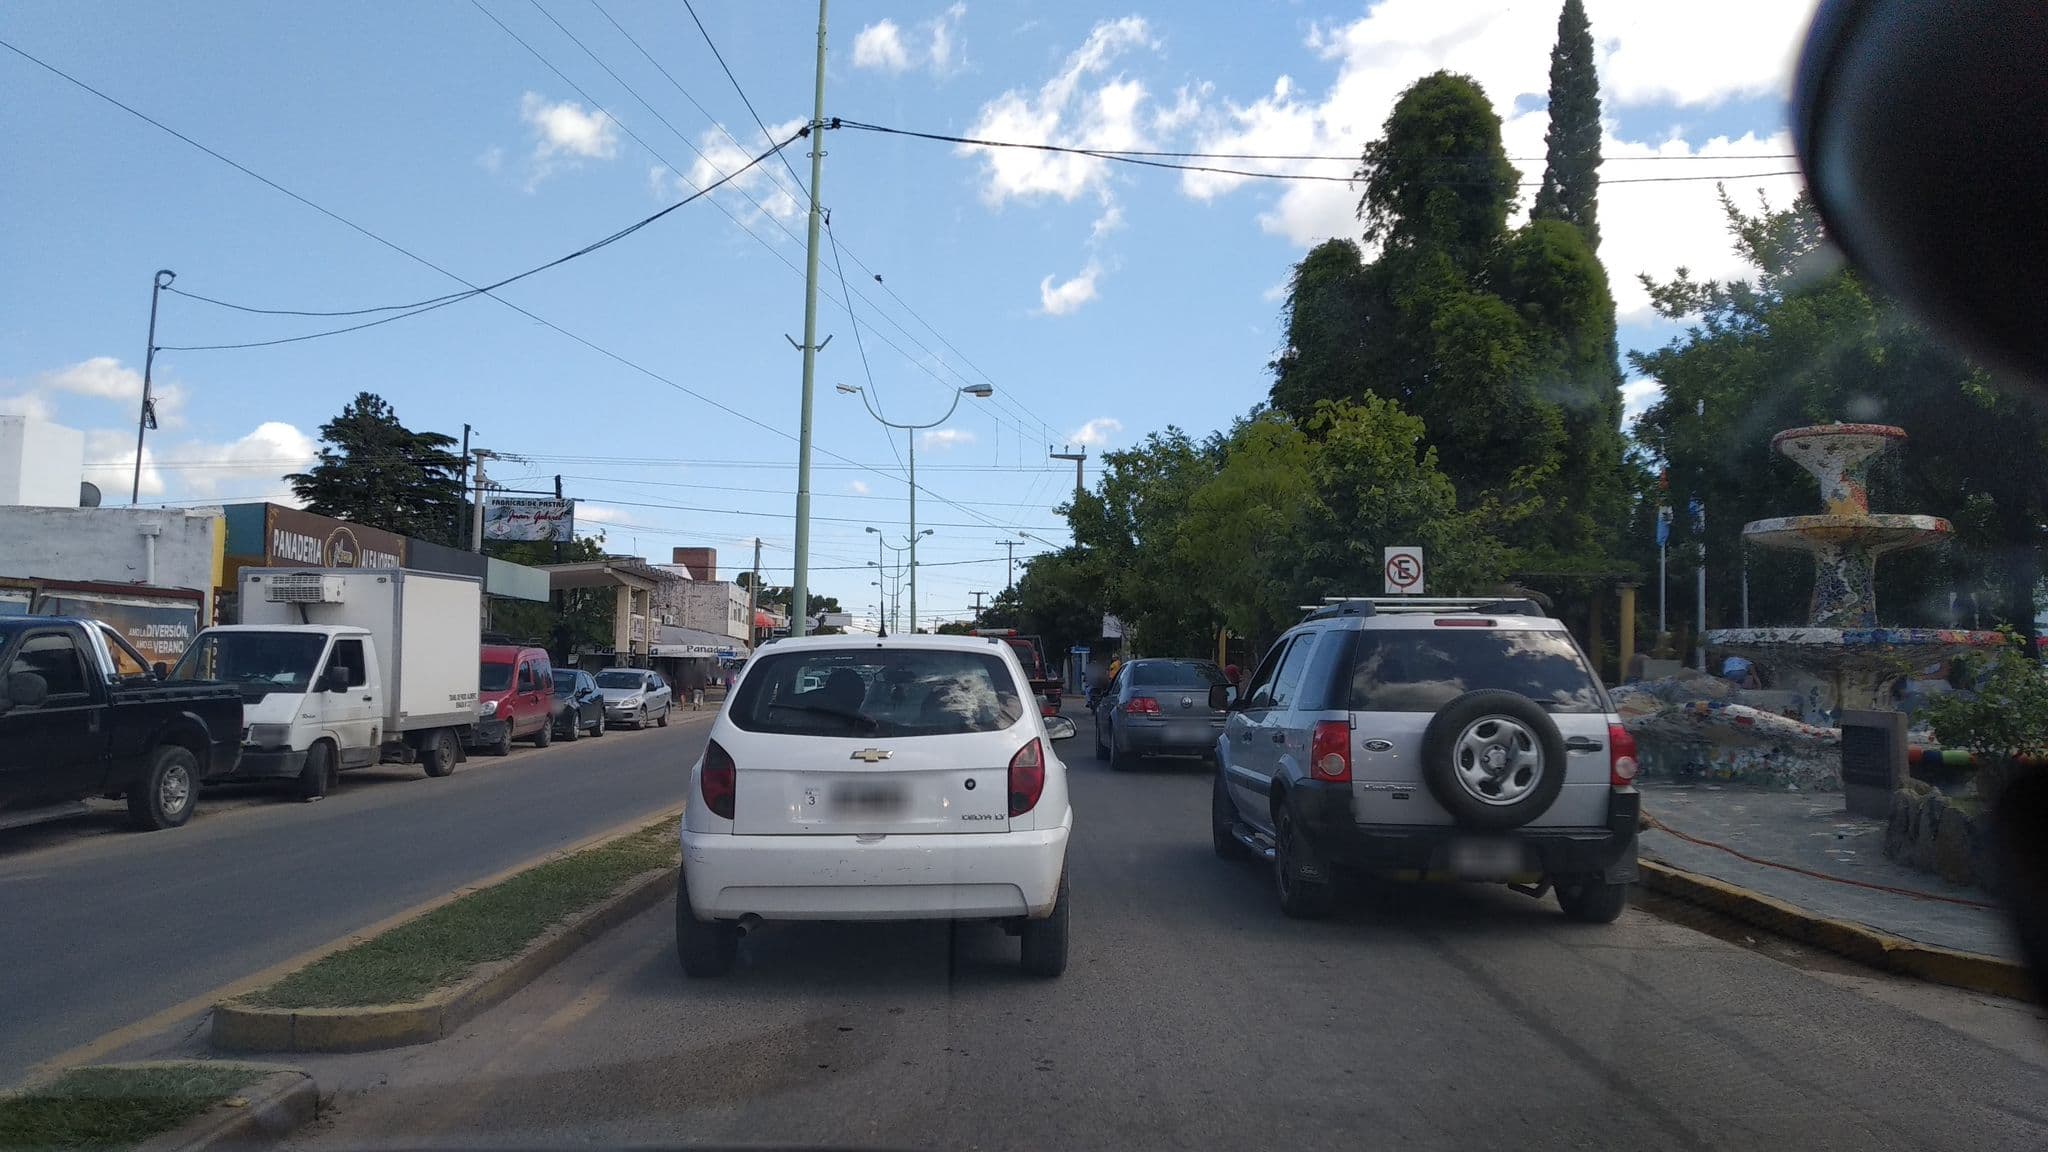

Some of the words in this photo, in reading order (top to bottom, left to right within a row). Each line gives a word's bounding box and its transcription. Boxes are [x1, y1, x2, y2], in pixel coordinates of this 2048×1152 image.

[492, 499, 525, 507] FABRICAS
[273, 528, 322, 565] PANADERIA
[1397, 559, 1410, 580] E
[146, 622, 189, 640] DIVERSIÓN,
[153, 640, 184, 654] VERANO
[808, 796, 816, 806] 3
